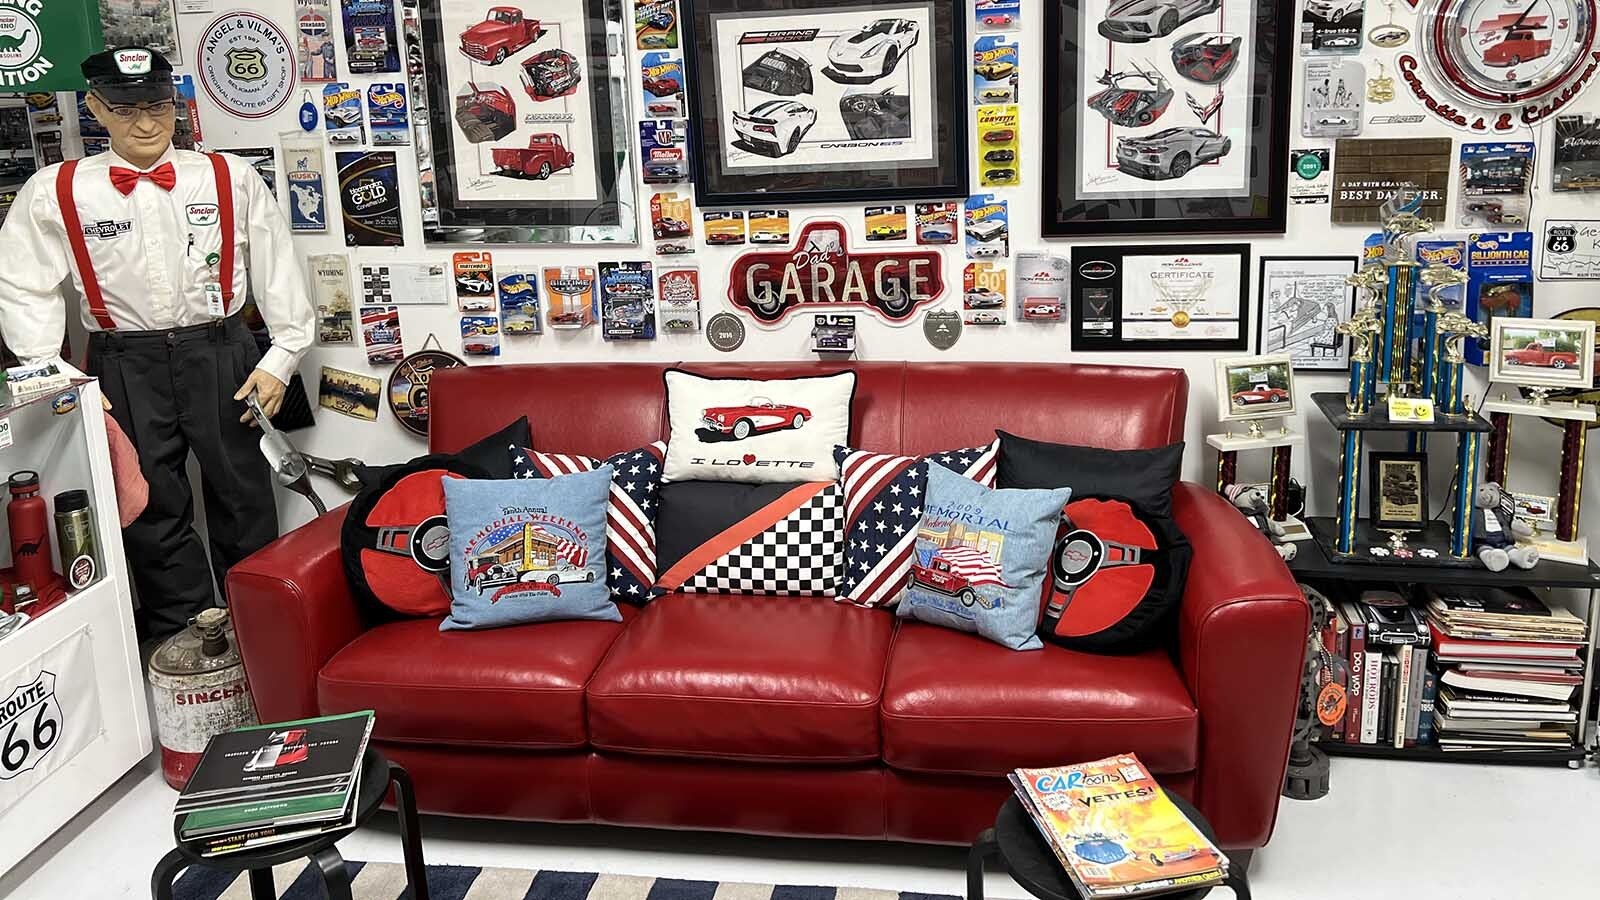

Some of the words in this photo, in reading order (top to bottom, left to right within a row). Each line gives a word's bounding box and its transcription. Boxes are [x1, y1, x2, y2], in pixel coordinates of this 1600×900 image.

[1558, 18, 1569, 30] 3
[207, 23, 234, 54] ANGEL
[237, 20, 244, 29] &
[247, 20, 285, 54] VILMA'S
[229, 35, 242, 44] EST
[119, 53, 149, 63] Sinclair
[234, 63, 259, 75] 66
[1505, 71, 1517, 81] 6
[208, 65, 230, 100] ORIGINAL
[231, 97, 257, 108] ROUTE
[266, 89, 280, 102] GIFT
[279, 66, 287, 88] SHOP
[980, 115, 1016, 123] CORVETTE
[1495, 113, 1513, 130] &
[653, 151, 681, 161] Mallory
[349, 180, 383, 195] bloomington
[352, 185, 386, 205] GOLD
[1340, 191, 1372, 200] BEST
[1376, 191, 1398, 200] DAY
[189, 207, 216, 216] Sinclair
[86, 221, 131, 235] CHEVROLET
[1553, 228, 1572, 236] ROUTE
[1552, 241, 1569, 252] 66
[792, 240, 845, 270] Dad's
[1472, 251, 1512, 260] BILLIONTH
[1513, 250, 1529, 259] CAR
[318, 269, 344, 277] WYOMING
[1150, 271, 1214, 279] CERTIFICATE
[746, 258, 932, 304] GARAGE
[979, 275, 999, 292] 90
[690, 457, 706, 465] I
[947, 501, 982, 515] 2009
[923, 504, 1017, 535] MEMORIAL
[465, 515, 523, 556] MEMORIAL
[530, 514, 588, 542] WEEKEND
[1352, 652, 1362, 672] DOO
[1369, 659, 1379, 682] HOT
[176, 681, 250, 705] SINCLAI
[1351, 675, 1361, 697] WOP
[0, 680, 46, 722] ROUTE
[1367, 684, 1378, 710] RODS
[1, 702, 57, 772] 66
[1077, 786, 1154, 808] VETTES!
[227, 834, 246, 843] START
[246, 831, 259, 839] FOR
